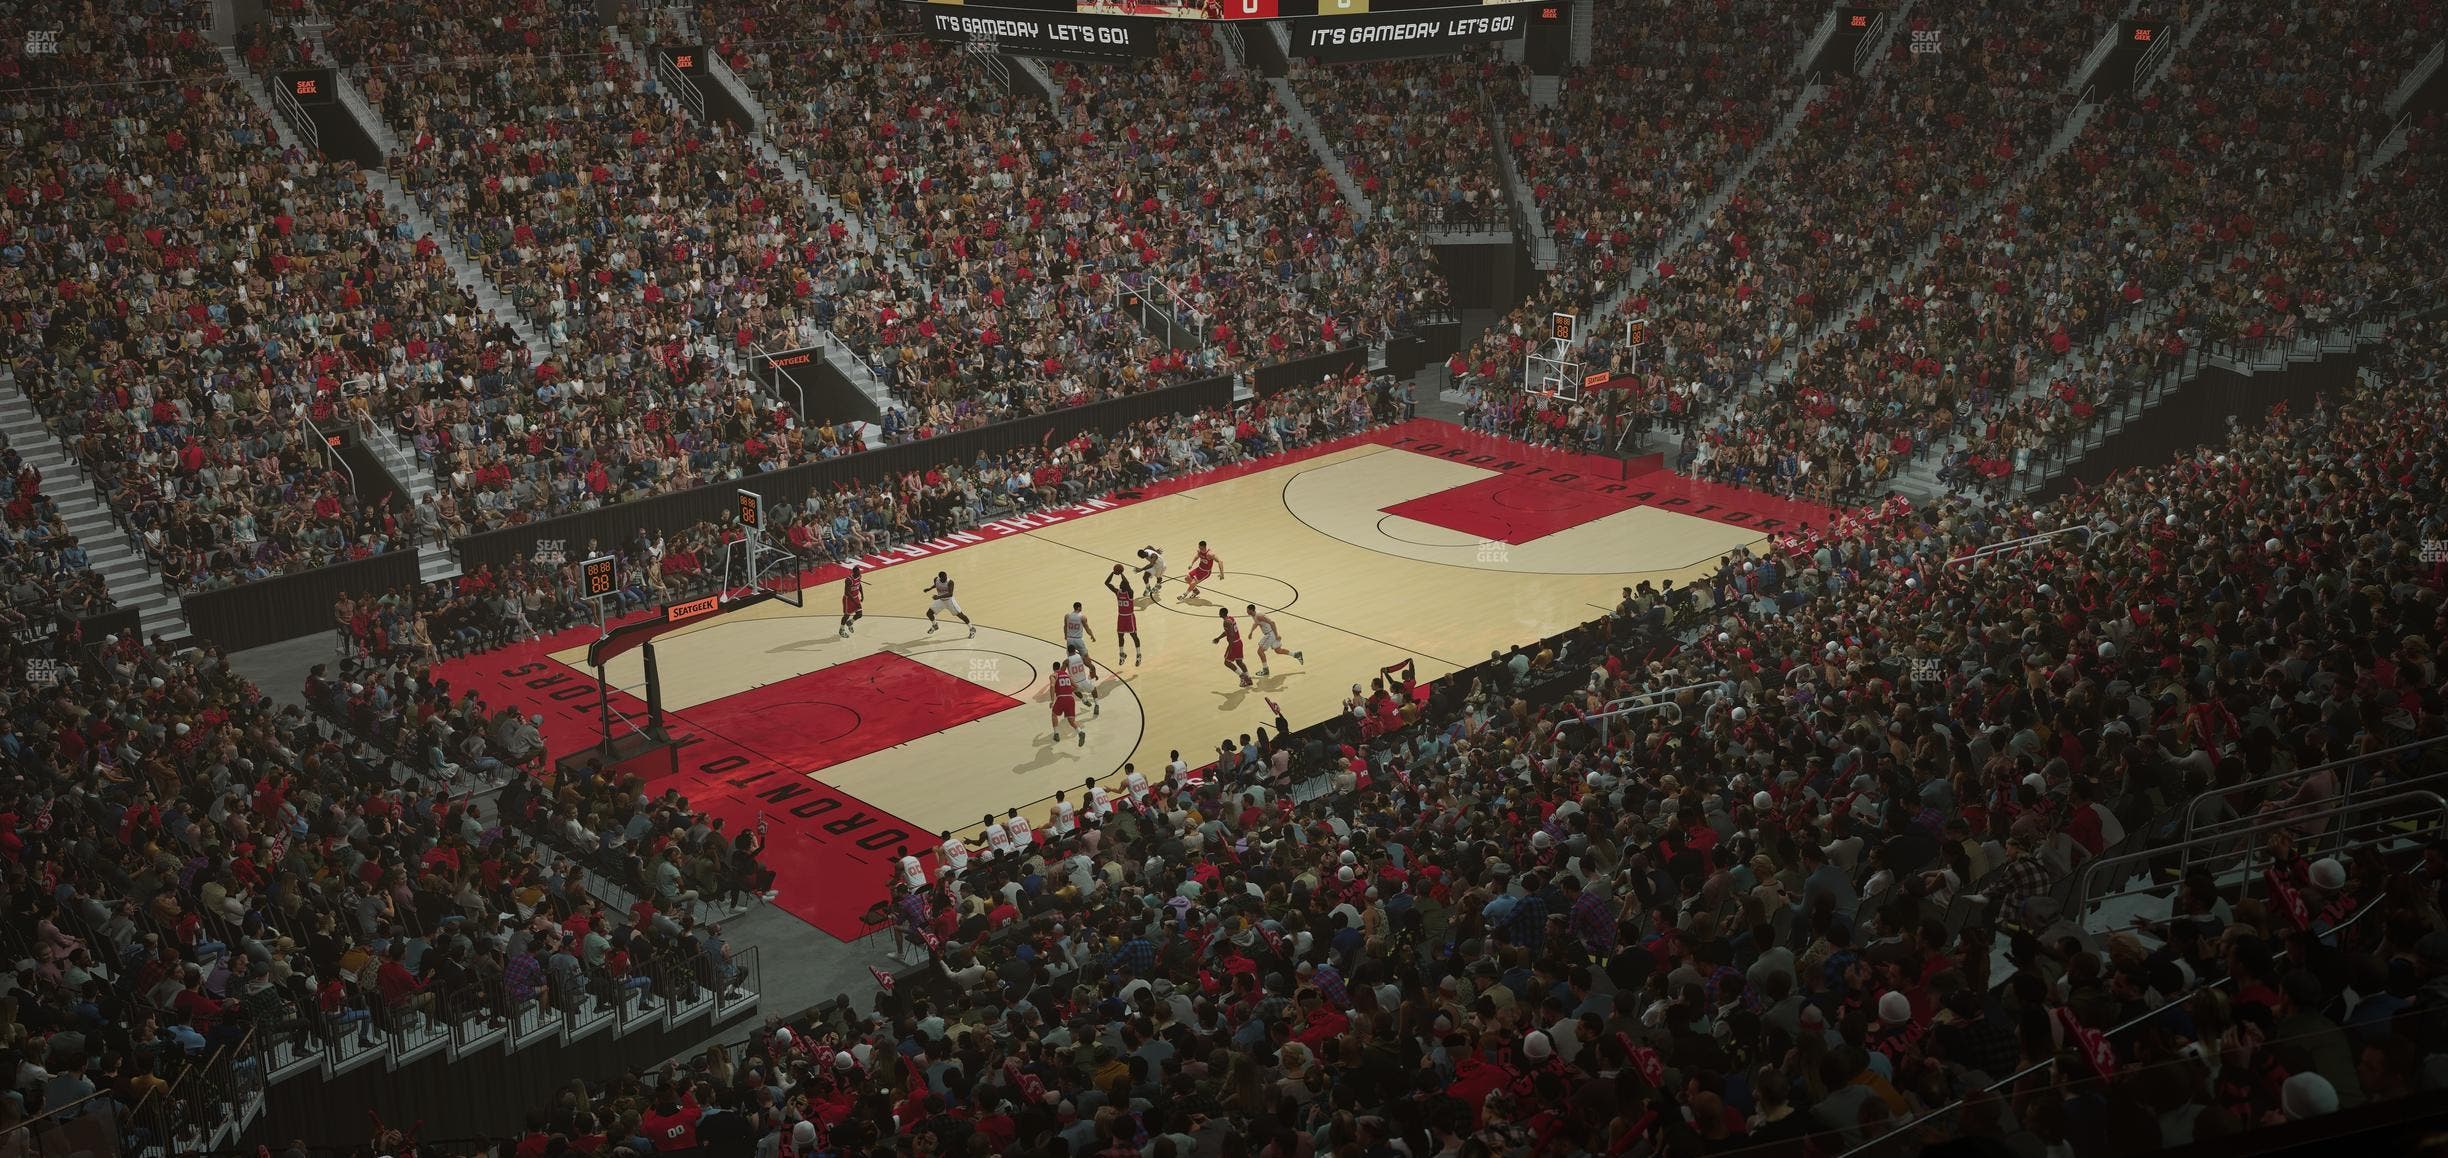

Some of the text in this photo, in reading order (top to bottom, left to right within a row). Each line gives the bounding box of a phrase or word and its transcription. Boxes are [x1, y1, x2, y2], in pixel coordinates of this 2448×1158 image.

[935, 14, 1130, 45] IT'S GAMEDAY LET'S GO!
[1310, 15, 1515, 46] IT'S GAMEDAY LET'S GO!
[296, 80, 317, 88] SEAT
[296, 87, 318, 95] GEEK
[1392, 436, 1580, 483] TORONTO
[742, 506, 755, 524] 88
[591, 574, 609, 593] 88
[673, 600, 714, 618] SEATGEEK
[1059, 678, 1072, 687] 00
[1011, 822, 1029, 835] 00
[948, 844, 965, 857] 00
[1002, 917, 1012, 928] 00
[667, 1124, 685, 1139] 00
